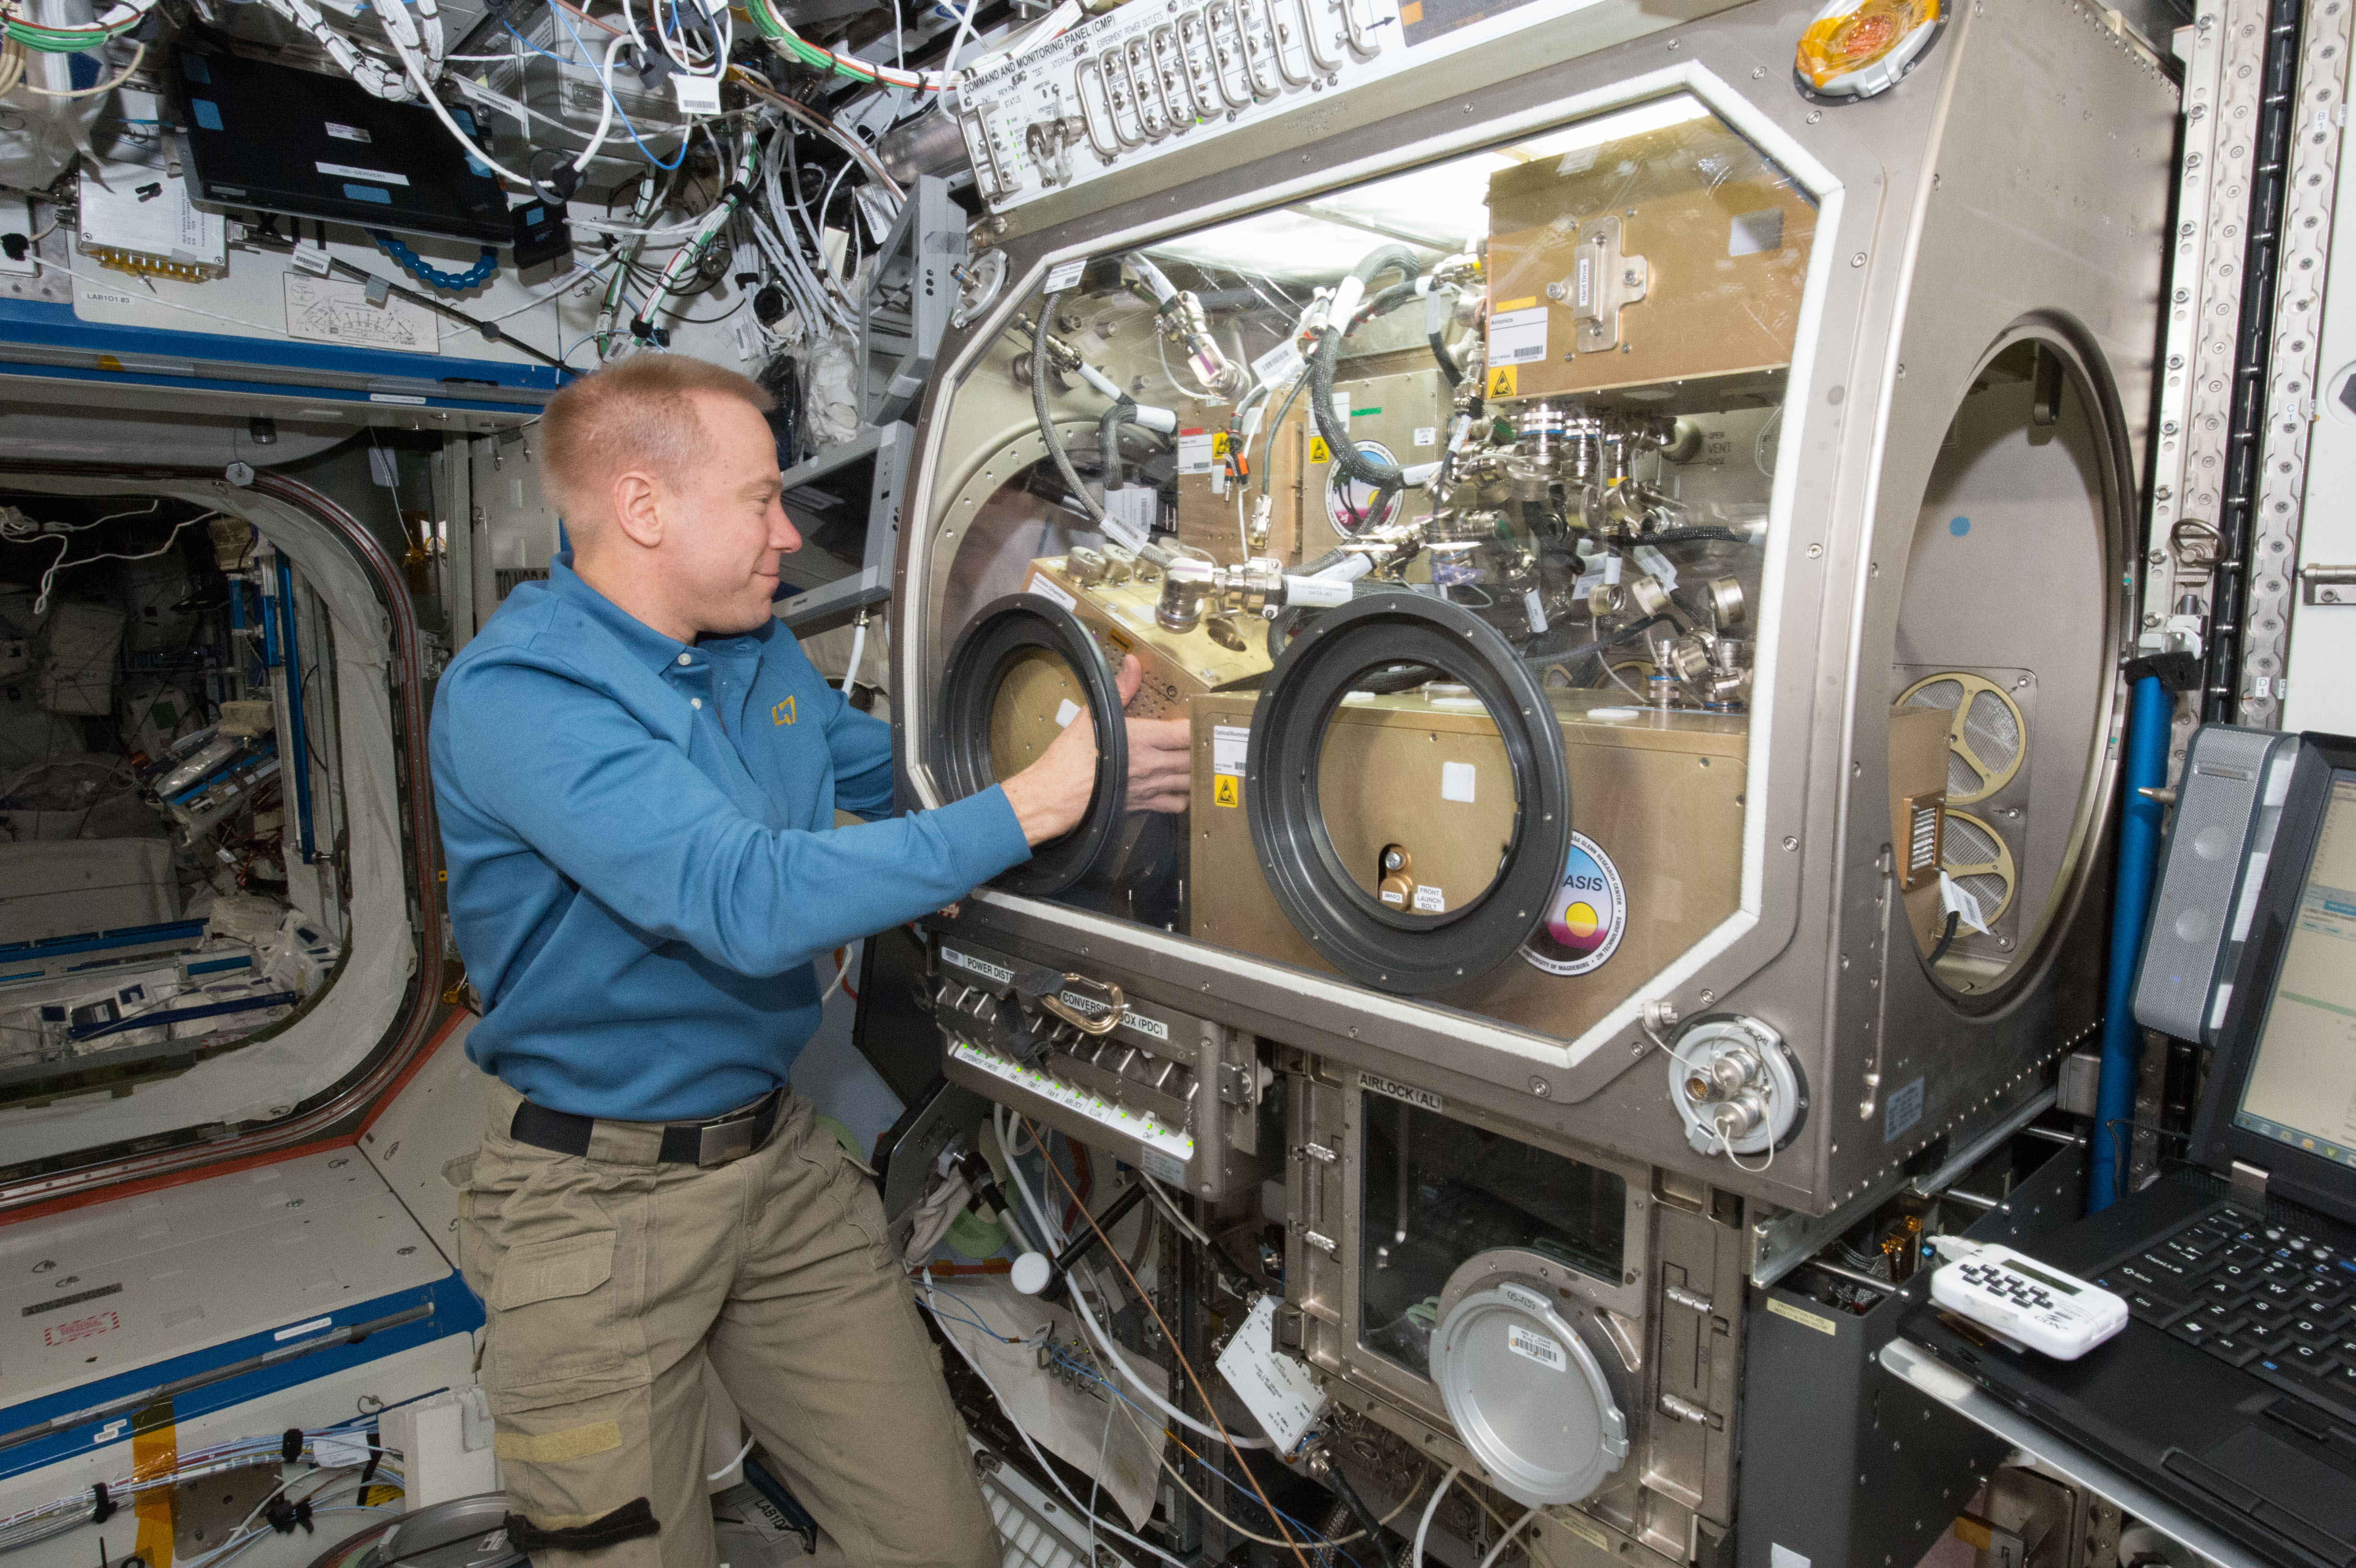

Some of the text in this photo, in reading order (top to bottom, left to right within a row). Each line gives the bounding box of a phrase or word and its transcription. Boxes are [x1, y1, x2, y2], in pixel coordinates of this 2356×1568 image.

[1097, 11, 1163, 48] EXPERIMENT POWER OUTLETS
[964, 14, 1115, 94] COMMAND AND MONITORING PANEL (CMP)
[1254, 62, 1266, 70] REMOTE
[1032, 67, 1044, 77] TEST
[1004, 97, 1021, 109] STATUS
[2318, 112, 2325, 120] B
[1491, 317, 1513, 326] Avionics
[2287, 404, 2295, 412] C
[1708, 442, 1732, 454] VENT
[1035, 576, 1067, 601] Bubble Chamber
[2259, 679, 2267, 687] D
[1581, 840, 1598, 854] GLENN
[1597, 853, 1616, 882] RESEARCH
[1613, 882, 1622, 905] CENTER
[1563, 875, 1603, 892] ASIS
[1385, 893, 1400, 901] Cover
[1420, 888, 1440, 897] FRONT
[1417, 896, 1441, 905] LAUNCH
[1421, 903, 1437, 911] BOLT
[1595, 916, 1622, 961] ZIN TECHNOLOGIES
[1522, 947, 1549, 968] UNIVERSITY
[1559, 961, 1590, 971] MAGDEBURG
[968, 957, 992, 974] POWER
[1063, 992, 1108, 1013] CONVERSI
[1138, 1016, 1163, 1035] (PDC)
[961, 1053, 999, 1073] EXPERIMENT POWERS
[1360, 1074, 1440, 1109] AIRLOCK (AL)
[1064, 1097, 1083, 1109] AIRLOCK
[1143, 1132, 1154, 1141] CMP
[2169, 1241, 2181, 1250] Tab
[2134, 1273, 2152, 1284] Shift
[2270, 1284, 2287, 1294] W
[2136, 1297, 2151, 1307] Ctrl
[2256, 1302, 2269, 1311] S
[2210, 1306, 2225, 1314] Z
[2311, 1303, 2325, 1312] E
[2253, 1326, 2269, 1335] X
[2299, 1321, 2313, 1330] D
[1535, 1339, 1550, 1349] Closed
[2299, 1347, 2313, 1356] C
[1255, 1371, 1264, 1381] VIDEO
